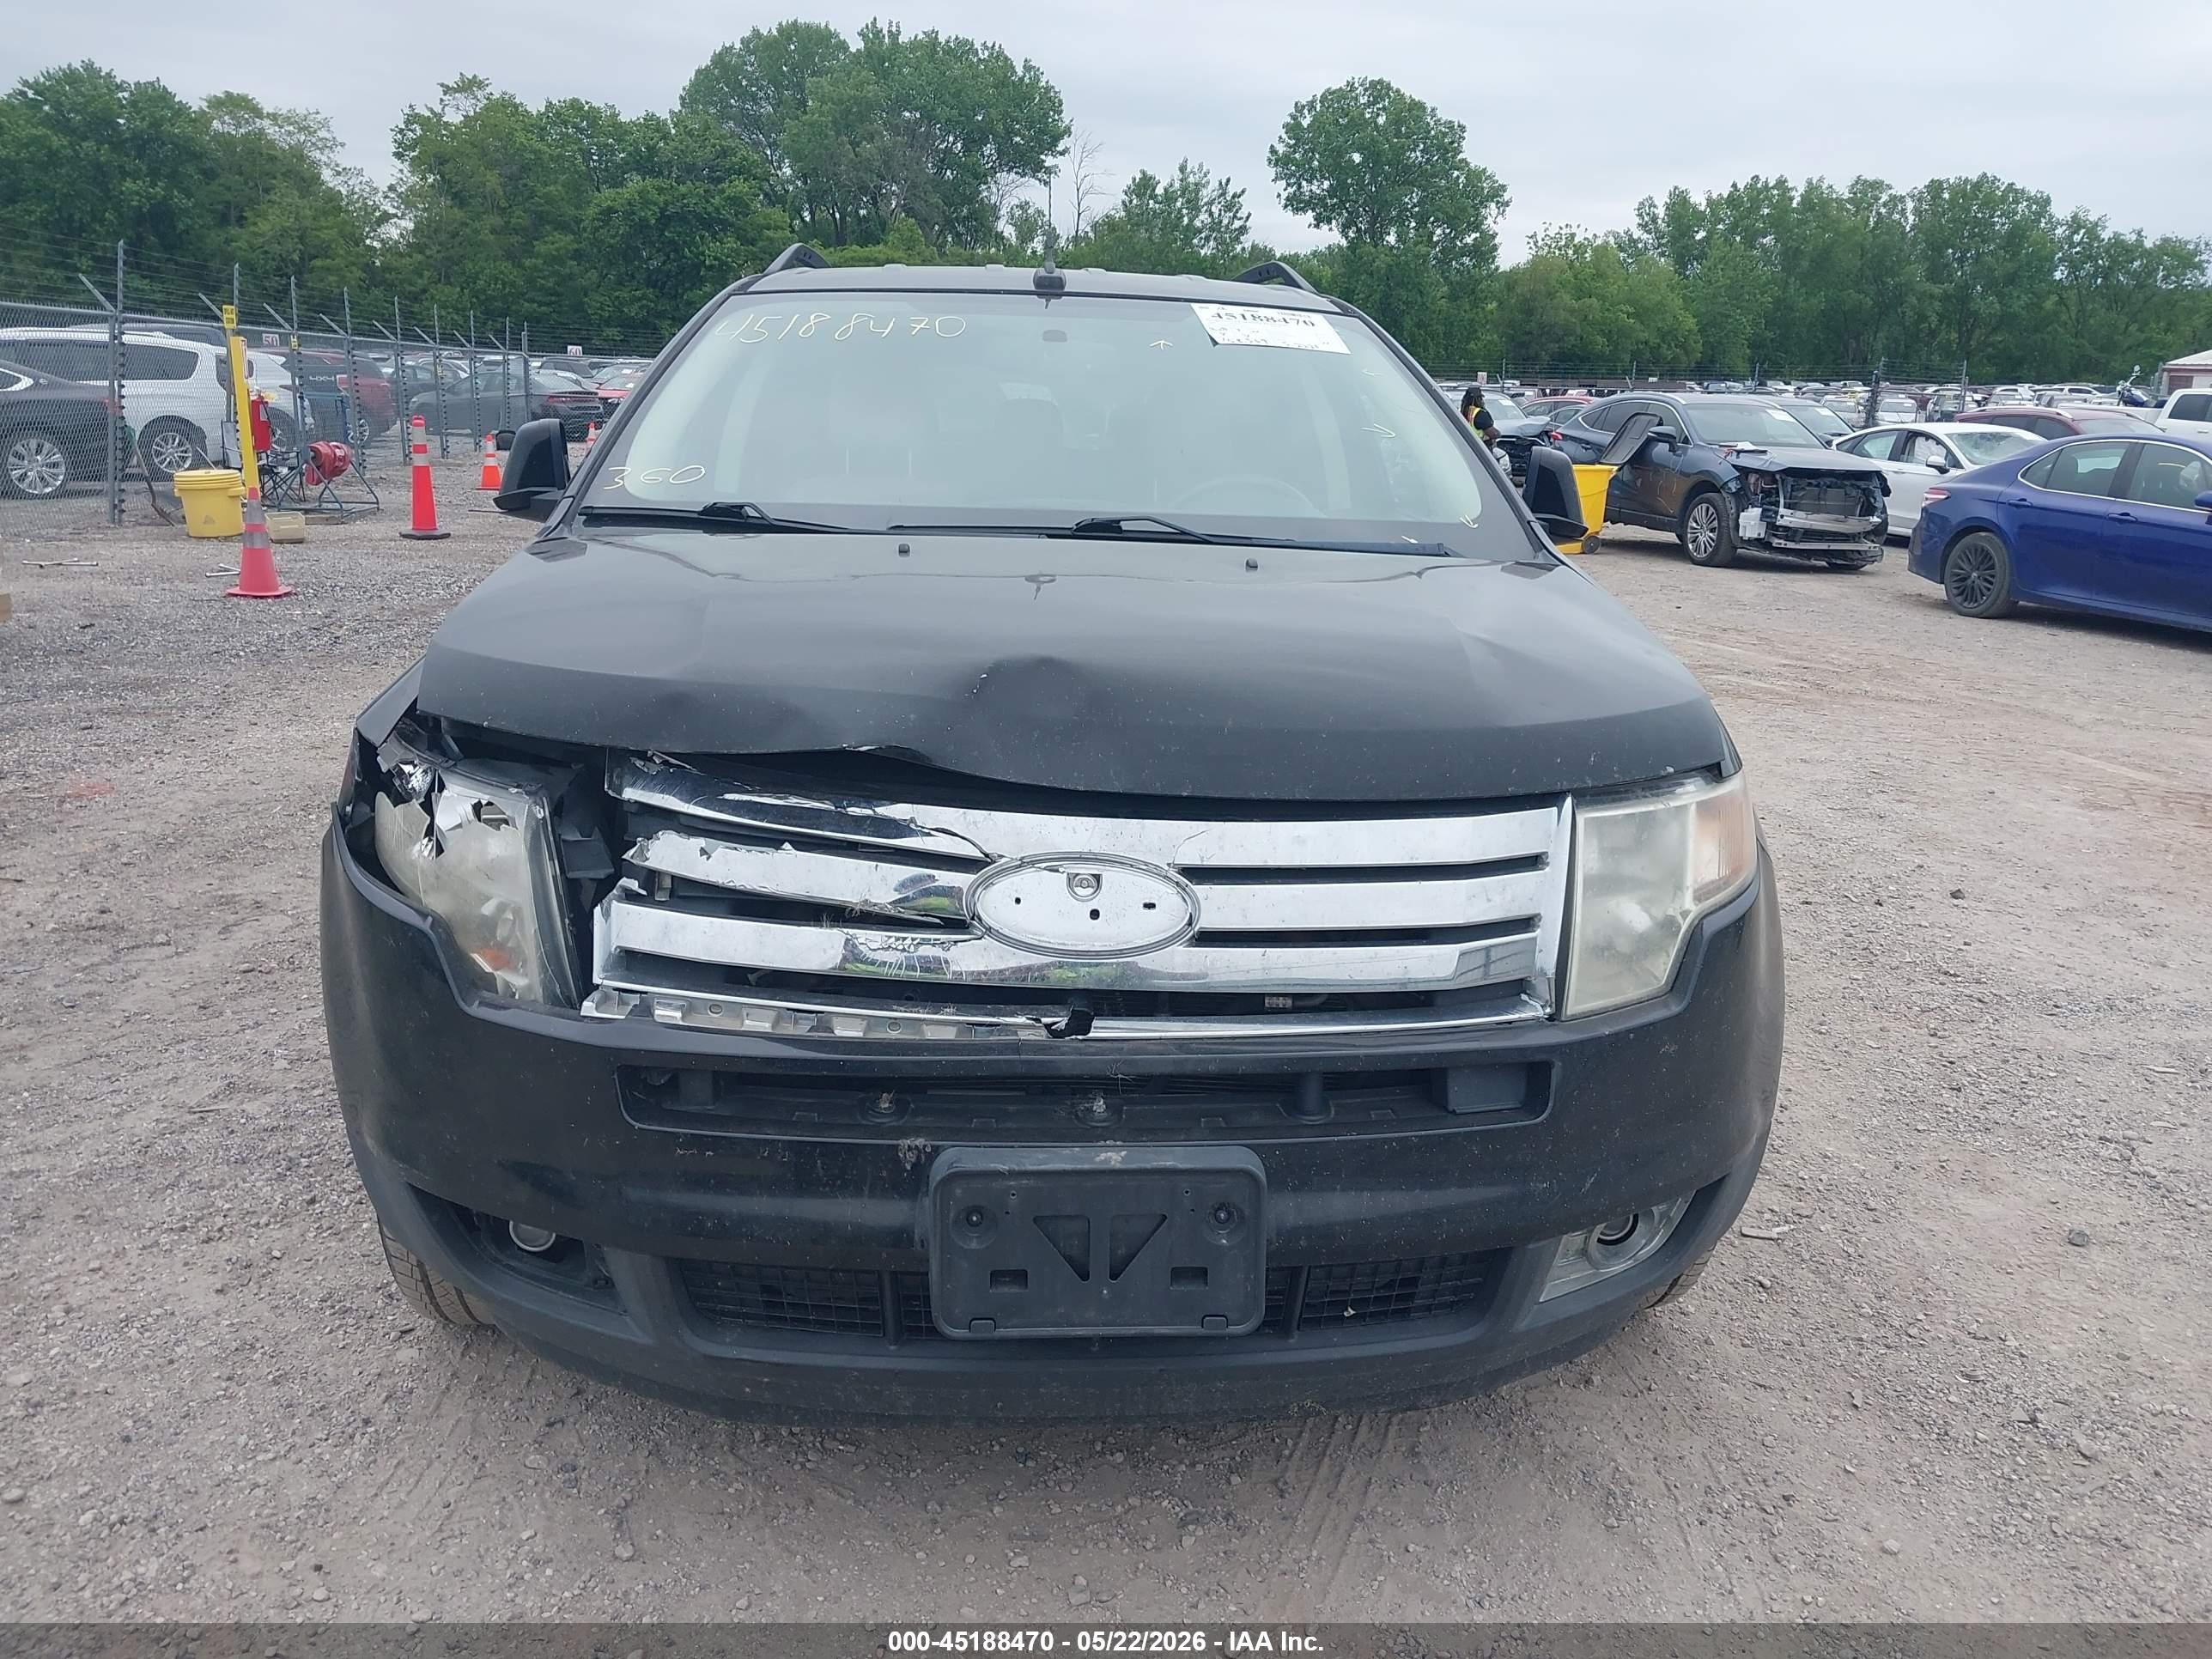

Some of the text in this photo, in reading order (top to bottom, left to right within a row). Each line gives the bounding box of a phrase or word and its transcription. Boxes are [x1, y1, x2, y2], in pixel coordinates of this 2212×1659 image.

[714, 312, 967, 343] 45188470
[1211, 312, 1316, 328] 45188470
[603, 465, 706, 490] 360
